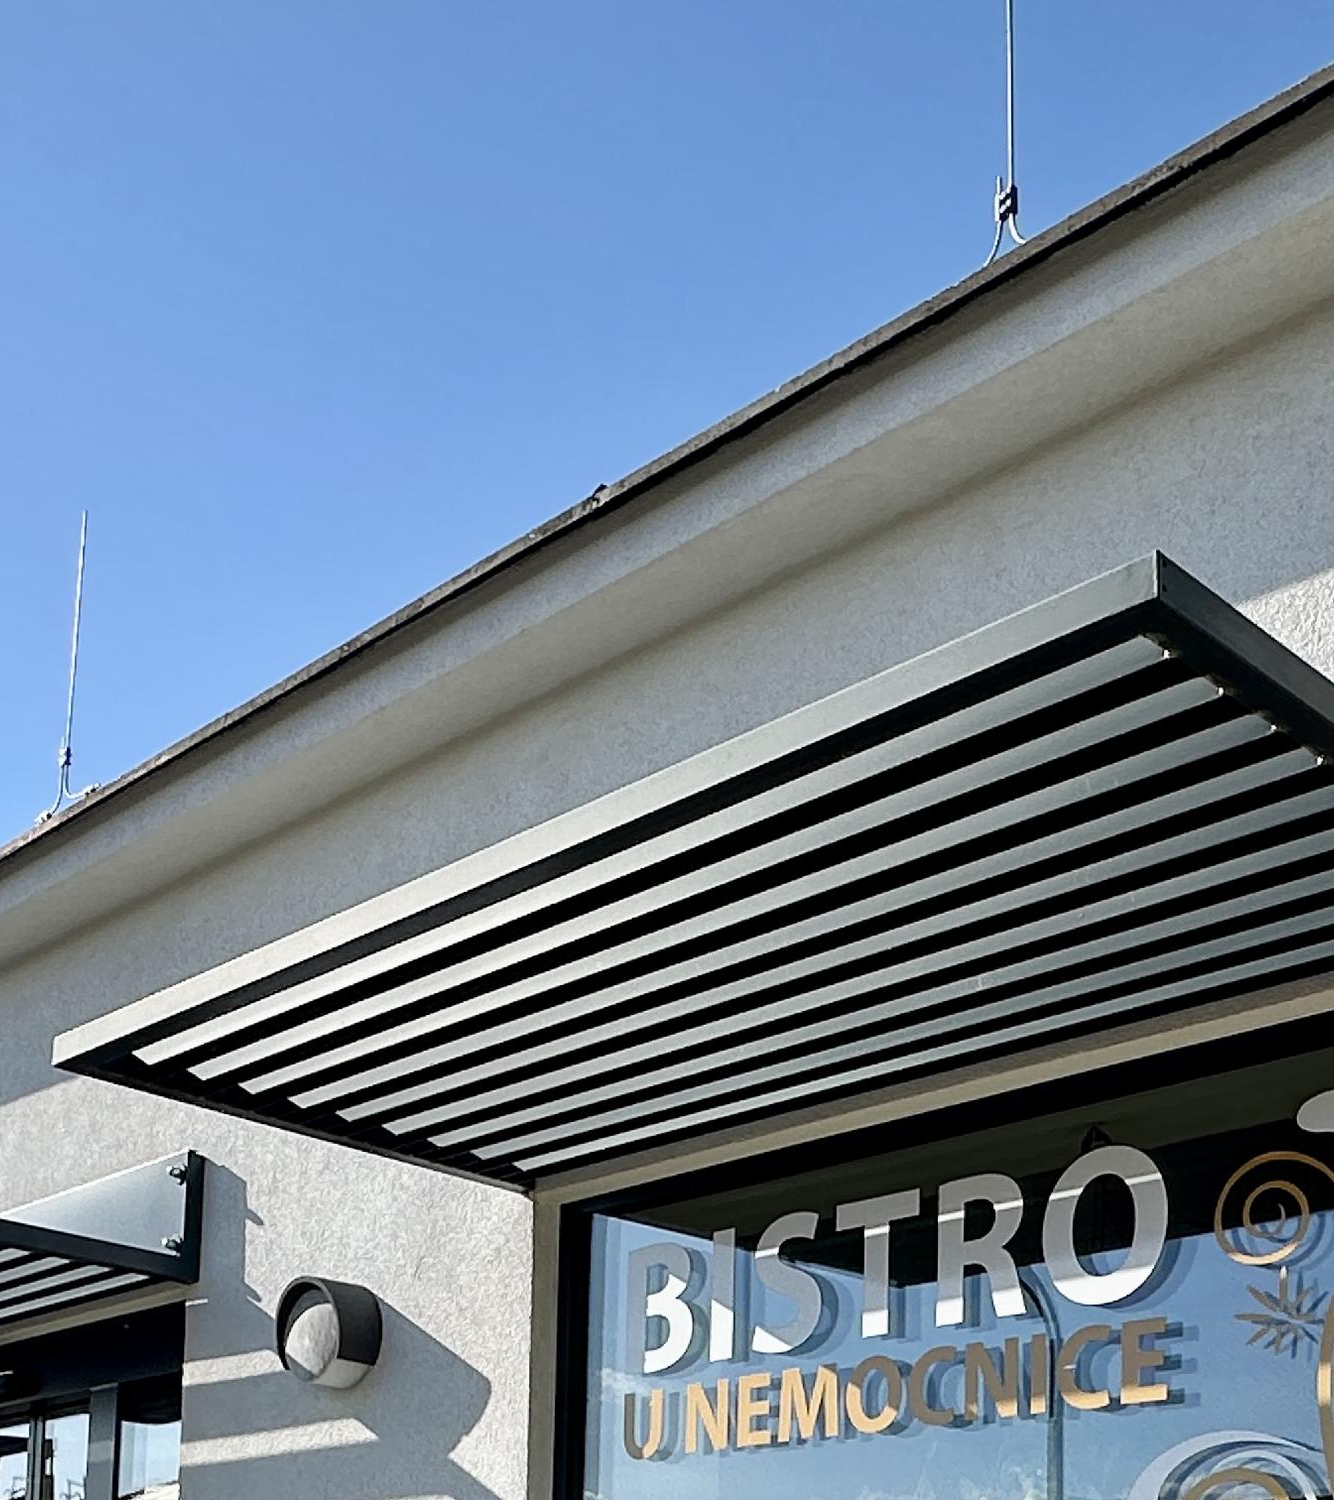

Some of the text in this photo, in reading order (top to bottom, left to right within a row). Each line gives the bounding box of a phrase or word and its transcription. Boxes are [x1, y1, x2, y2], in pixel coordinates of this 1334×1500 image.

[626, 1145, 1168, 1374] BISTRO
[624, 1316, 1168, 1460] U NEMOCNICE
